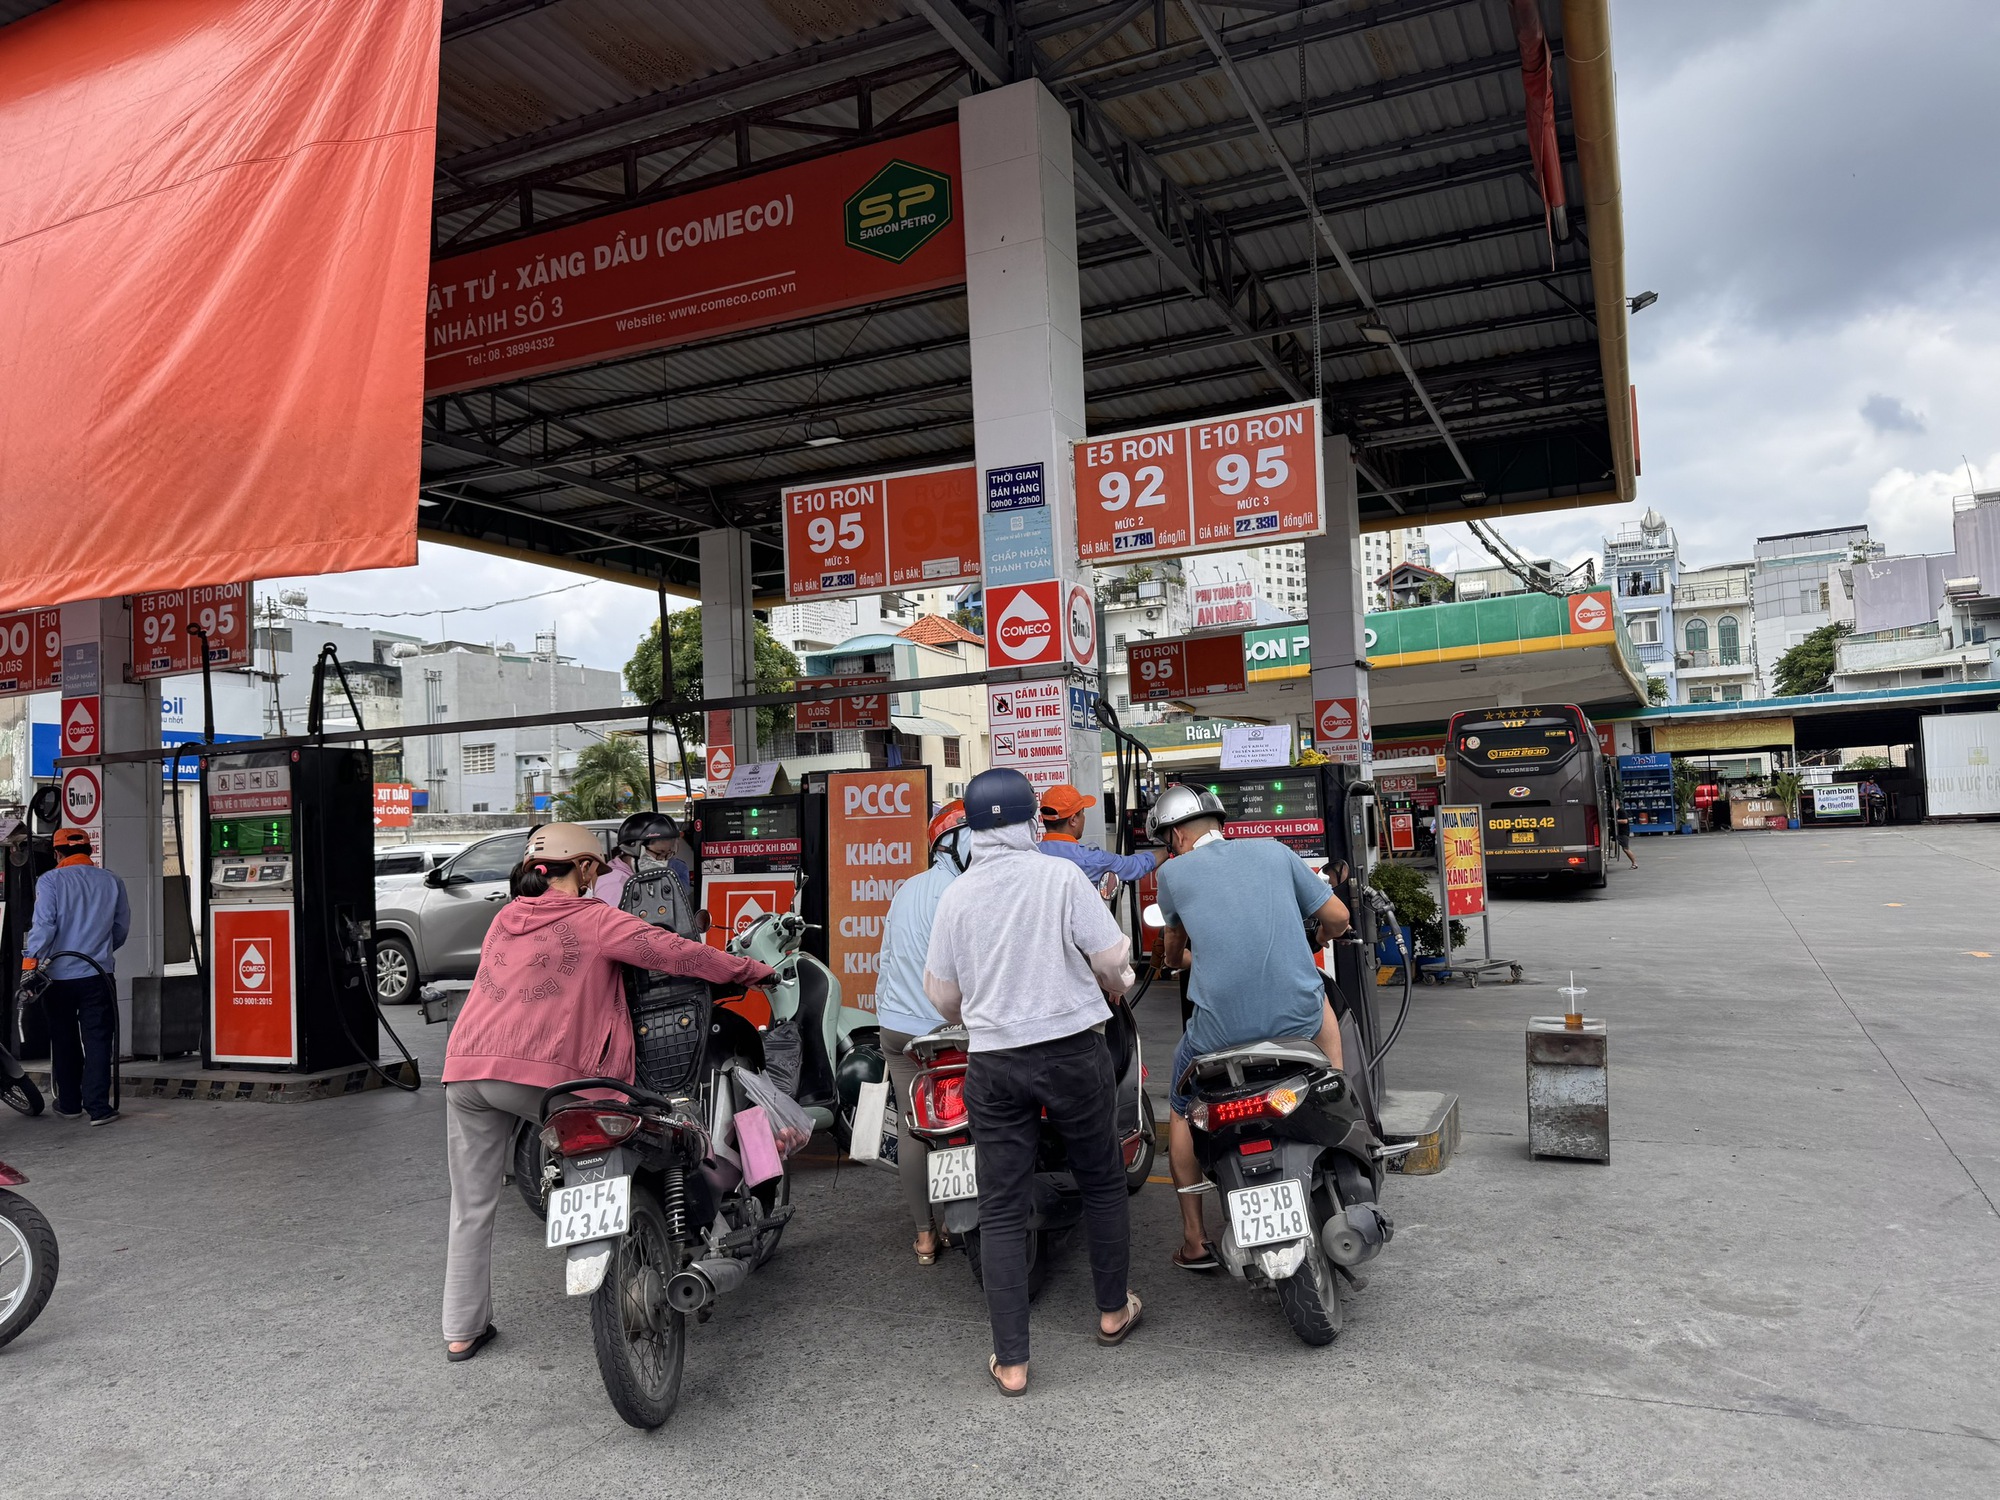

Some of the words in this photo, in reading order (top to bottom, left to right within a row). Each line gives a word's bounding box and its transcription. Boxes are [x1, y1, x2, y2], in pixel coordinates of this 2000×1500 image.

[859, 182, 935, 229] SP
[859, 221, 899, 240] SAIGON
[900, 212, 936, 231] PETRO
[427, 284, 457, 319] ẬT
[463, 269, 497, 303] TƯ
[516, 252, 586, 291] XĂNG
[594, 229, 648, 272] DẦU
[656, 193, 794, 257] (COMECO)
[616, 311, 666, 332] Website:
[668, 281, 797, 322] www.comeco.com.vn
[433, 312, 508, 347] NHÁNH
[514, 291, 545, 327] SỐ
[551, 296, 564, 317] 3
[1200, 423, 1239, 450] E10
[1246, 412, 1303, 442] RON
[1086, 443, 1114, 468] E5
[1122, 434, 1174, 462] RON
[991, 471, 1013, 484] THỜI
[1015, 470, 1039, 481] GIAN
[1215, 445, 1289, 496] 95
[990, 486, 1010, 498] BÁN
[1012, 483, 1040, 495] HÀNG
[1098, 465, 1166, 512] 92
[793, 492, 825, 514] E10
[830, 485, 875, 510] RON
[991, 499, 1013, 508] 00h00
[1018, 495, 1040, 505] 23h00
[1237, 497, 1259, 510] MỨC
[1263, 496, 1269, 506] 3
[1115, 517, 1136, 530] MỨC
[1138, 516, 1144, 526] 2
[1199, 526, 1211, 539] GIÁ
[1213, 524, 1232, 537] BÁN:
[1235, 514, 1278, 532] 22.330
[1283, 511, 1314, 528] đồng/lít
[807, 511, 865, 554] 95
[1081, 543, 1093, 555] GIÁ
[1094, 539, 1111, 553] BÁN:
[1114, 532, 1154, 549] 21.780
[1158, 530, 1186, 545] đồng/lít
[824, 556, 843, 567] MỨC
[844, 555, 850, 565] 3
[991, 549, 1017, 562] CHẤP
[1020, 546, 1047, 560] NHẬN
[989, 562, 1021, 574] THANH
[1024, 558, 1051, 569] TOÁN
[793, 580, 804, 592] GIÁ
[821, 573, 855, 588] 22.330
[893, 569, 905, 581] GIÁ
[141, 597, 155, 613] E5
[158, 591, 184, 610] RON
[193, 587, 213, 605] E10
[215, 583, 242, 600] RON
[1195, 589, 1211, 604] PHỤ
[1236, 583, 1252, 598] ÔTÔ
[40, 611, 57, 628] E10
[200, 603, 234, 637] 95
[1197, 607, 1214, 624] AN
[1216, 600, 1252, 623] NHIÊN
[1578, 610, 1607, 619] COMECO
[143, 613, 176, 645] 92
[1001, 622, 1051, 638] COMECO
[45, 631, 61, 658] 9
[1133, 648, 1151, 659] E10
[1154, 644, 1179, 657] RON
[1140, 659, 1173, 681] 95
[1015, 686, 1037, 699] CẤM
[1040, 684, 1059, 697] LỬA
[161, 697, 184, 714] bil
[1016, 706, 1034, 719] NO
[1036, 703, 1061, 717] FIRE
[68, 725, 95, 736] COMECO
[1323, 718, 1353, 727] COMECO
[1502, 719, 1526, 728] VIP
[1017, 728, 1030, 739] CẤM
[1031, 726, 1042, 738] HÚT
[1043, 724, 1062, 737] THUỐC
[1018, 747, 1028, 759] NO
[1030, 744, 1063, 758] SMOKING
[1274, 782, 1281, 790] 4
[1383, 780, 1396, 788] 95
[1400, 779, 1414, 787] 92
[260, 798, 272, 807] KHI
[377, 788, 391, 803] XỊT
[844, 783, 911, 814] PCCC
[386, 804, 410, 814] CÔNG
[1276, 804, 1283, 814] 2
[1747, 801, 1760, 812] CẤM
[1761, 800, 1774, 812] LỬA
[1442, 812, 1459, 828] MUA
[1460, 808, 1478, 828] NHỚT
[1488, 817, 1555, 830] 60B-053.42
[1742, 815, 1753, 827] CẤM
[1754, 815, 1765, 826] HÚT
[1228, 827, 1234, 835] 0
[1237, 823, 1272, 834] TRƯỚC
[1274, 824, 1292, 833] KHI
[1295, 822, 1318, 832] BƠM
[705, 844, 719, 855] TRẢ
[732, 845, 738, 853] 0
[739, 842, 764, 853] TRƯỚC
[766, 843, 779, 852] KHI
[780, 841, 797, 851] BƠM
[846, 838, 912, 865] KHÁCH
[1453, 836, 1474, 860] TẶNG
[1446, 866, 1469, 886] XĂNG
[242, 965, 266, 973] COMECO
[233, 997, 243, 1005] ISO
[577, 1156, 603, 1167] HONDA
[931, 1173, 977, 1200] 220.8
[560, 1180, 616, 1216] 60-F4
[1239, 1184, 1294, 1217] 59-XB
[551, 1205, 625, 1245] 043.44
[1240, 1209, 1304, 1244] 475.48
